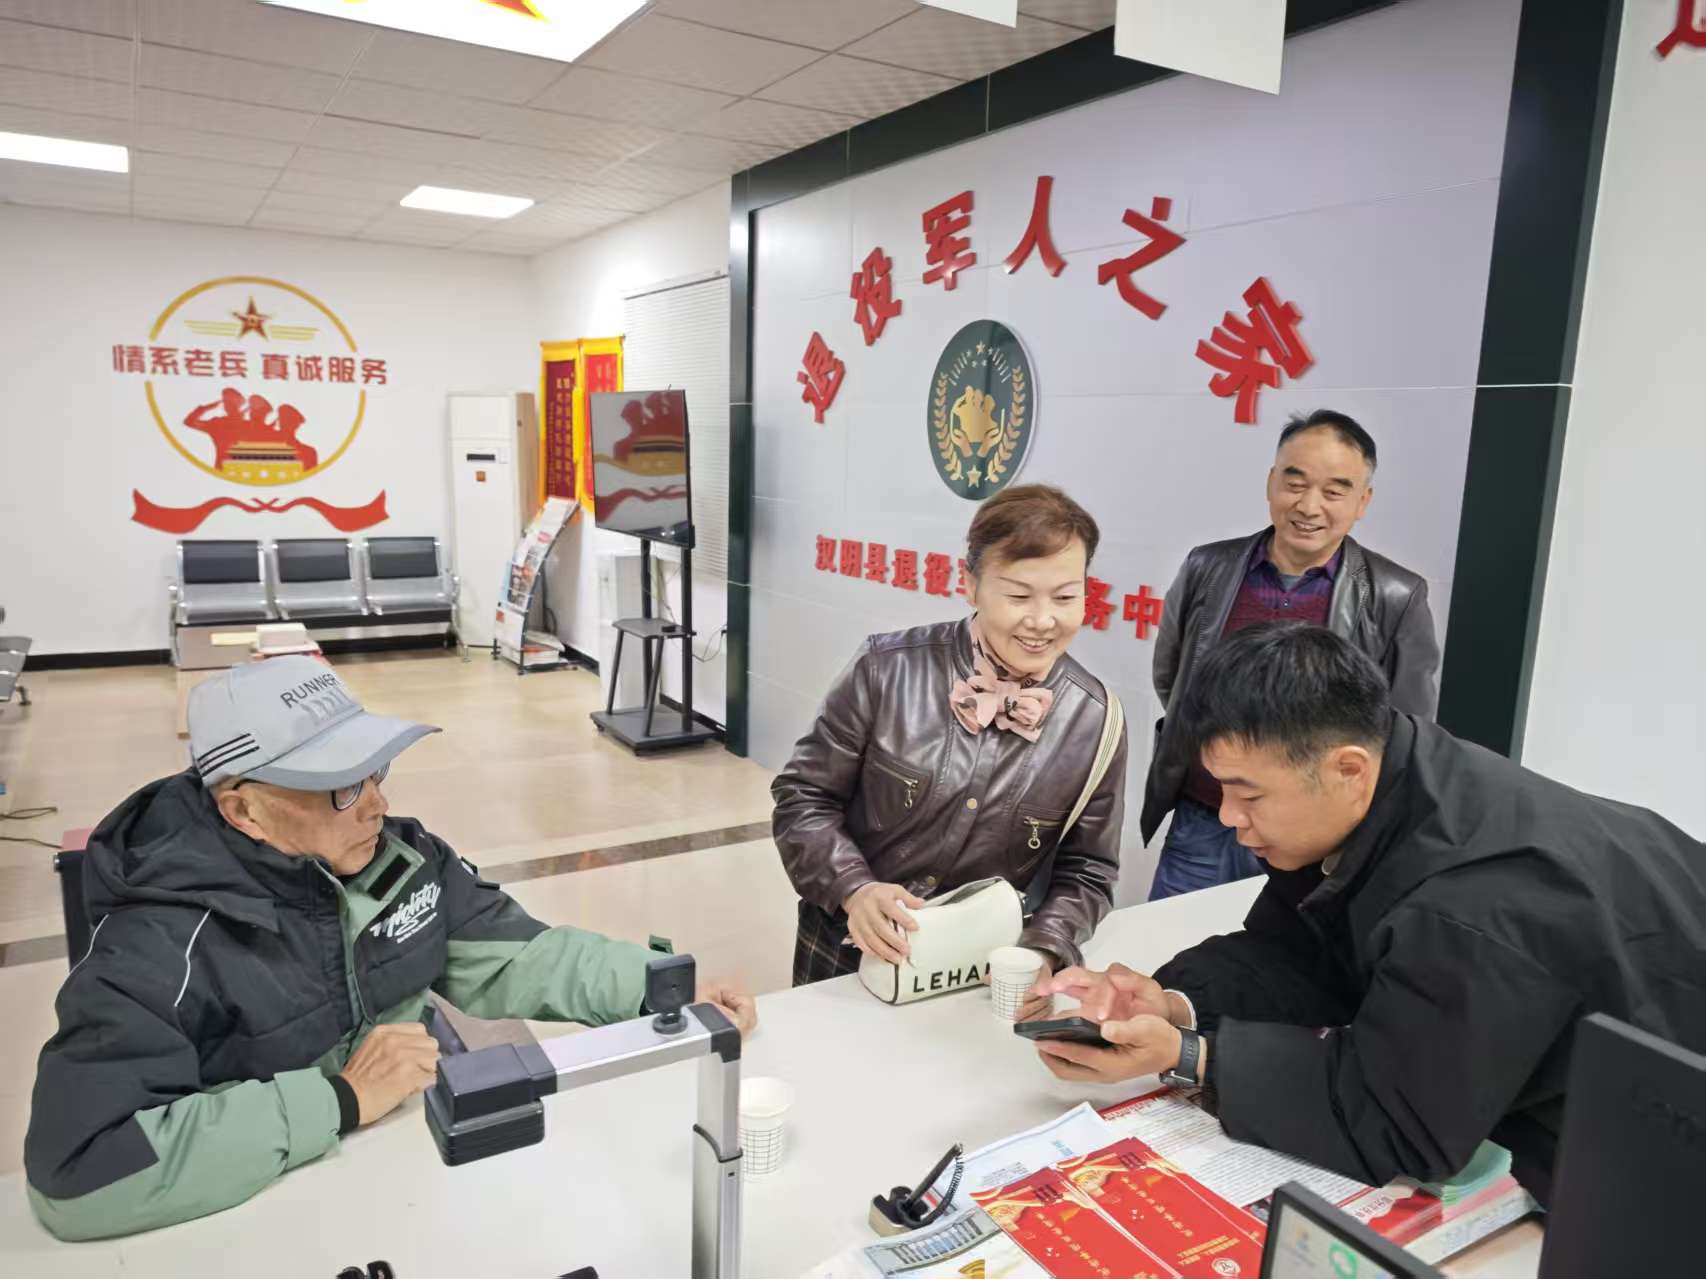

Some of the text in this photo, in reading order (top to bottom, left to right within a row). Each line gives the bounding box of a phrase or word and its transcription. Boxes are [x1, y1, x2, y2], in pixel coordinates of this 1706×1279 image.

[112, 344, 388, 385] 情系老兵 真诚服务
[797, 175, 1315, 425] 退役军人之家
